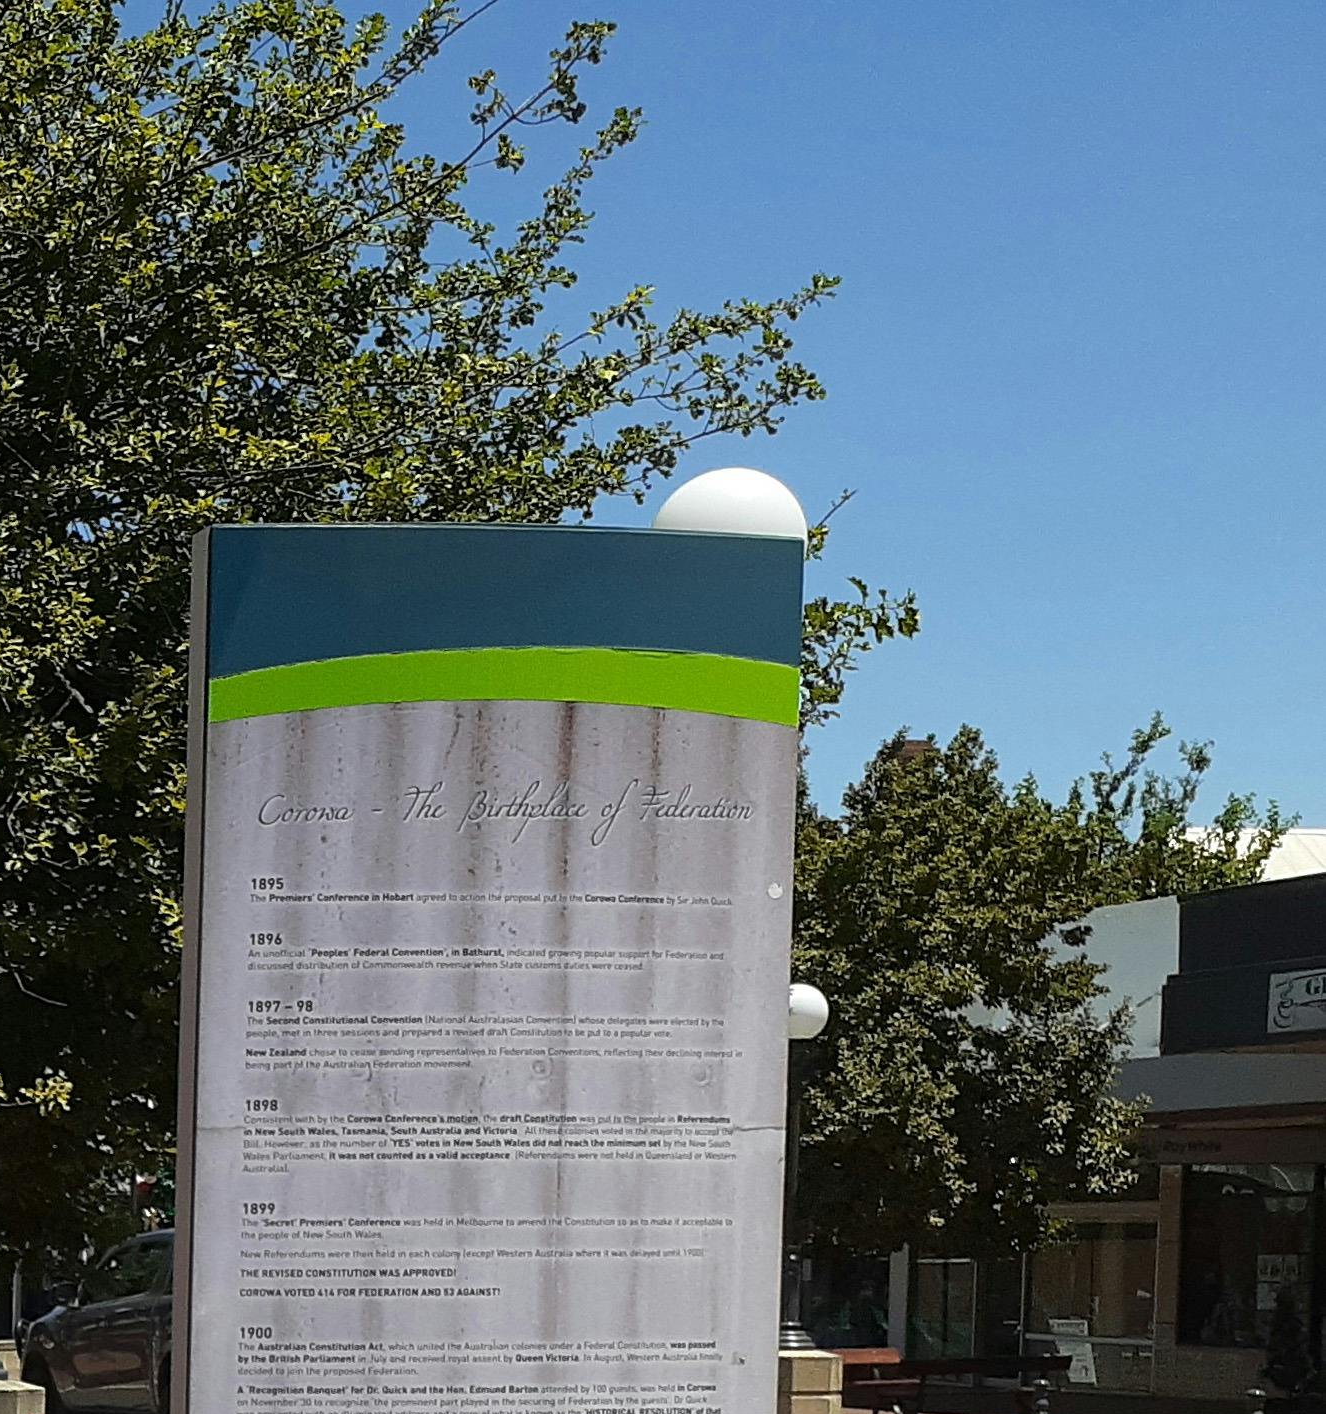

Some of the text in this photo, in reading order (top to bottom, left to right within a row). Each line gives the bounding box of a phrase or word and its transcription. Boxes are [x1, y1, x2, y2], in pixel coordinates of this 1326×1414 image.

[257, 778, 755, 847] Corowa The Birthplace of Federation
[251, 876, 284, 890] 1895
[249, 932, 283, 946] 1896
[248, 998, 314, 1013] 1897 98
[245, 1098, 279, 1112] 1898
[242, 1201, 276, 1215] 1899
[240, 1326, 273, 1340] 1900
